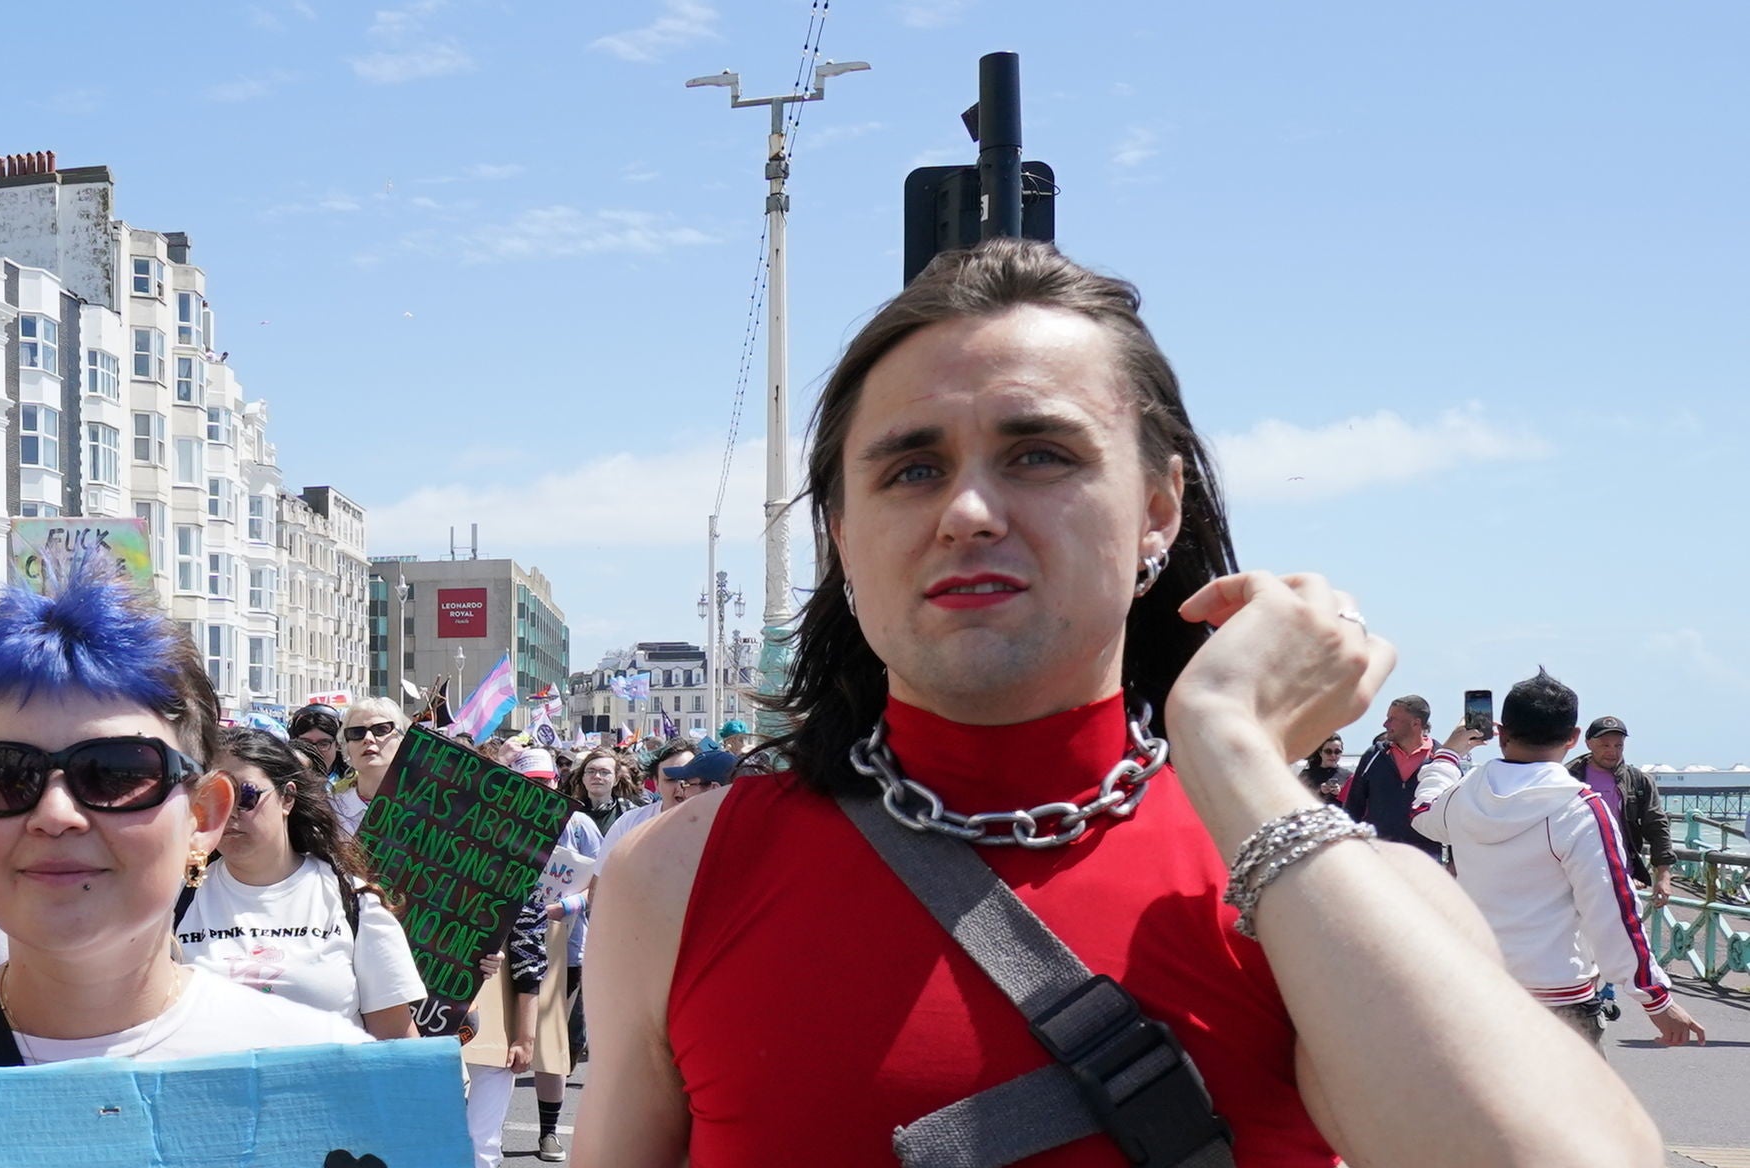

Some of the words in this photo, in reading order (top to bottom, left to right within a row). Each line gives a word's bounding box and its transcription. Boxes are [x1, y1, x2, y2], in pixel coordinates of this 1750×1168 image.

[46, 527, 112, 551] FUCK
[441, 602, 483, 610] LEONARDO
[396, 766, 458, 820] WAS
[455, 800, 554, 864] ABOUT
[479, 767, 569, 834] GENDER
[358, 831, 507, 932] THEMSELVES
[499, 860, 540, 900] FOR
[209, 926, 245, 939] PINK
[250, 926, 308, 938] TENNIS
[402, 904, 441, 945] NO
[436, 921, 489, 968] ONE
